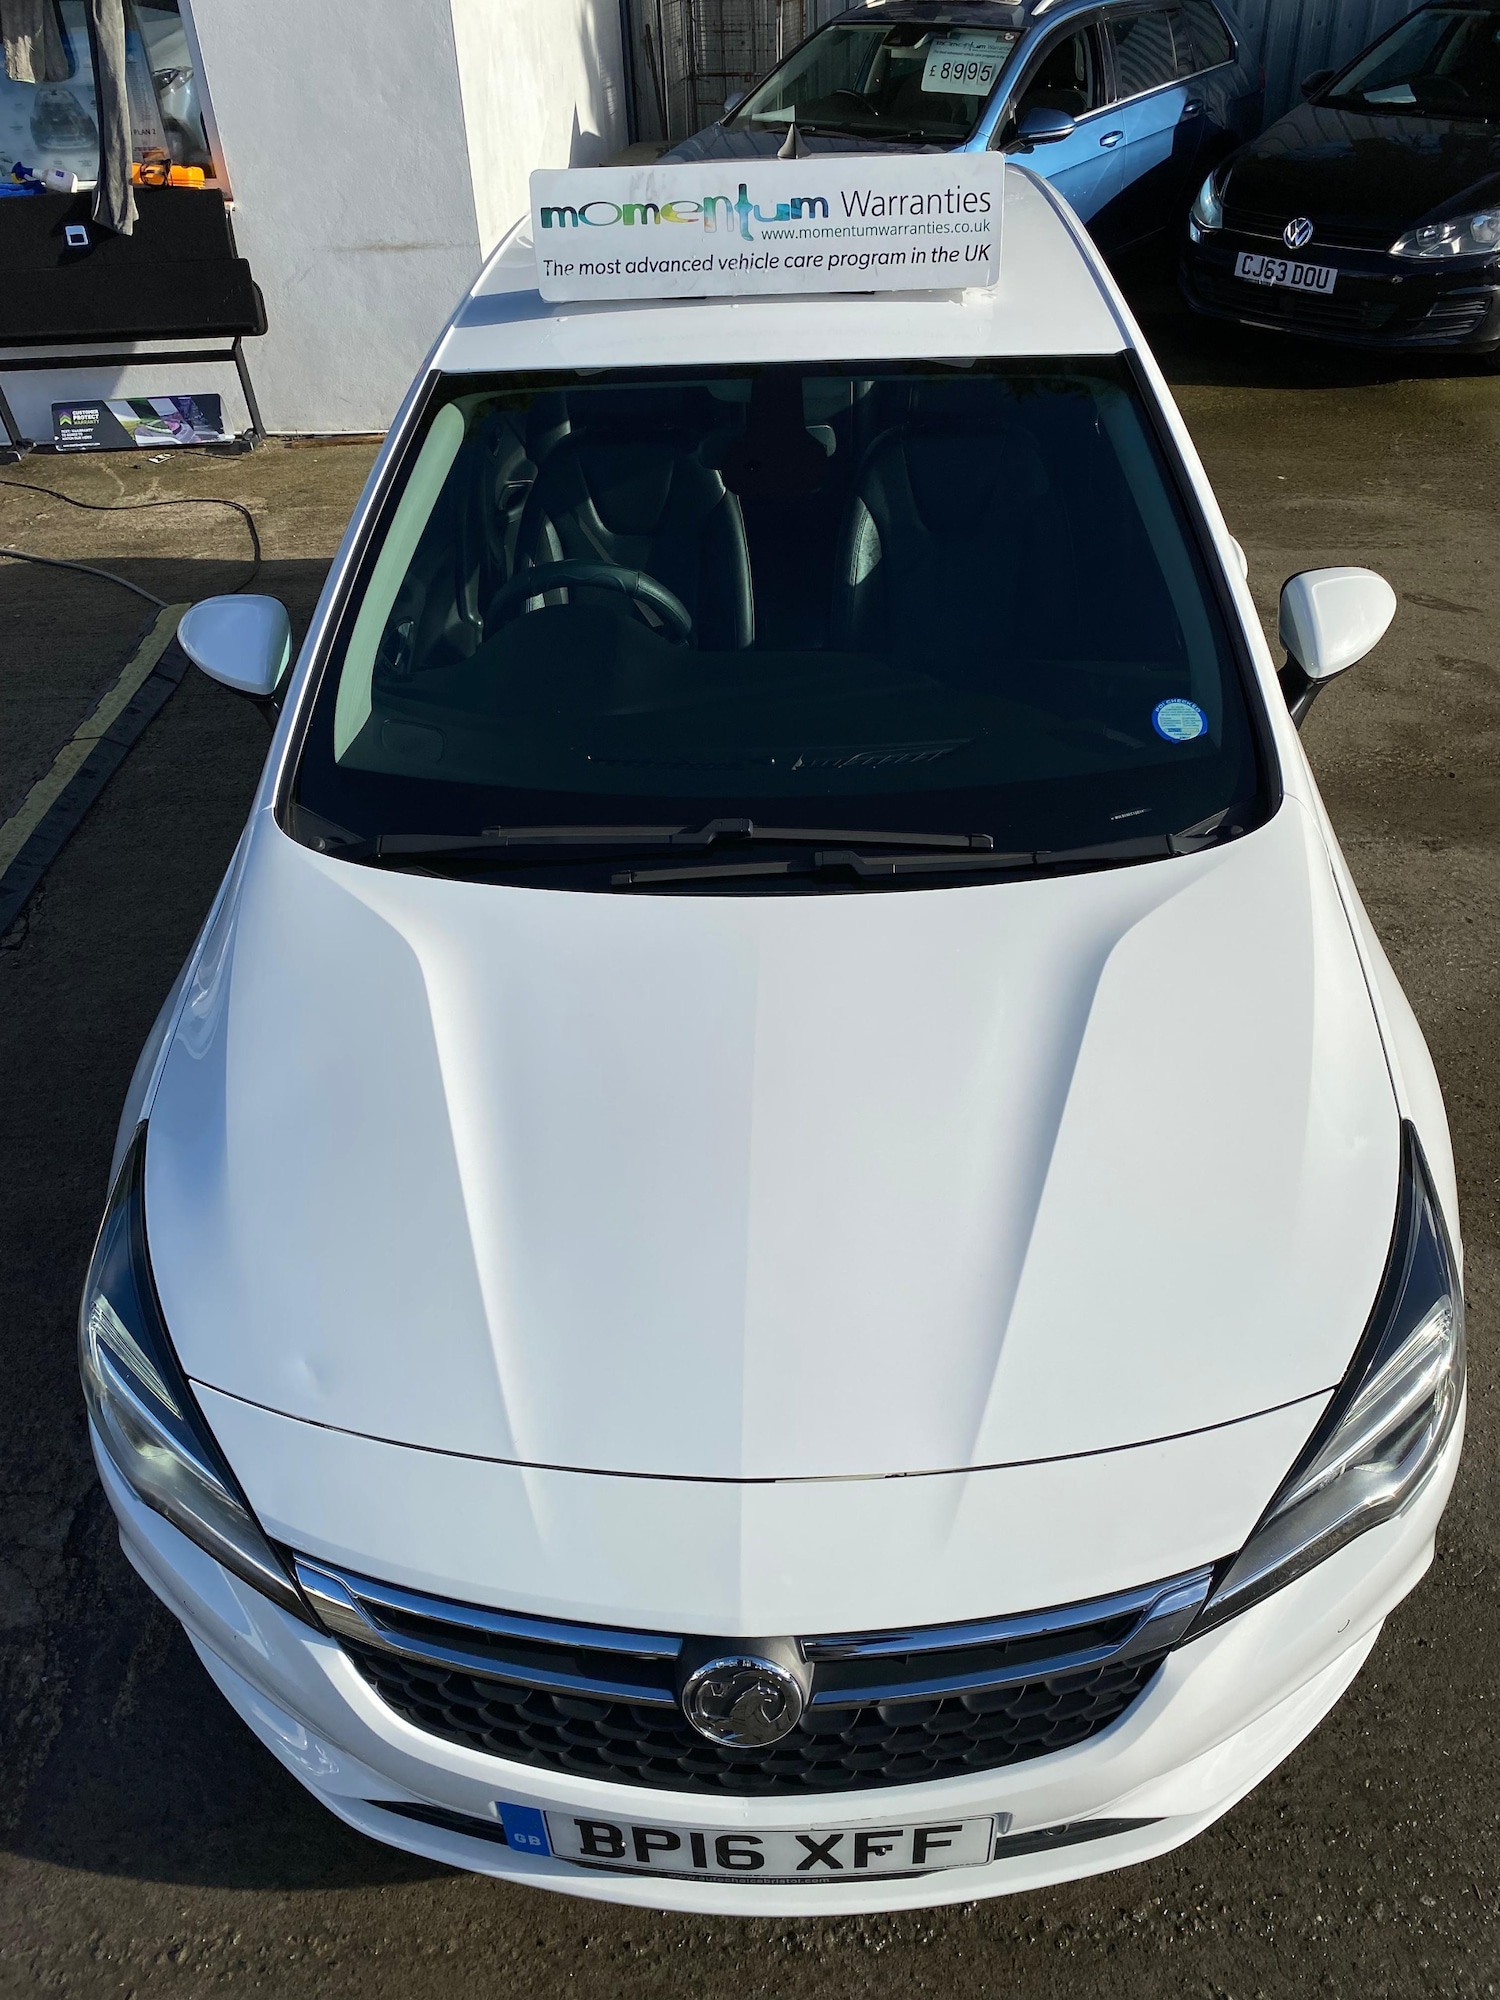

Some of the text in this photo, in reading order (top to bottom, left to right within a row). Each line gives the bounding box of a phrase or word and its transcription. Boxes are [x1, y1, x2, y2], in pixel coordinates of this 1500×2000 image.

[929, 62, 993, 82] £ 8995
[540, 183, 992, 242] momentum Warranties
[761, 218, 991, 240] www.momentumwarranties.co.uk
[543, 243, 991, 277] The most advanced vehicle care program in the UK
[1241, 254, 1330, 289] CJ63 DOU
[513, 1832, 542, 1847] GB
[573, 1818, 963, 1872] BP16 XFF
